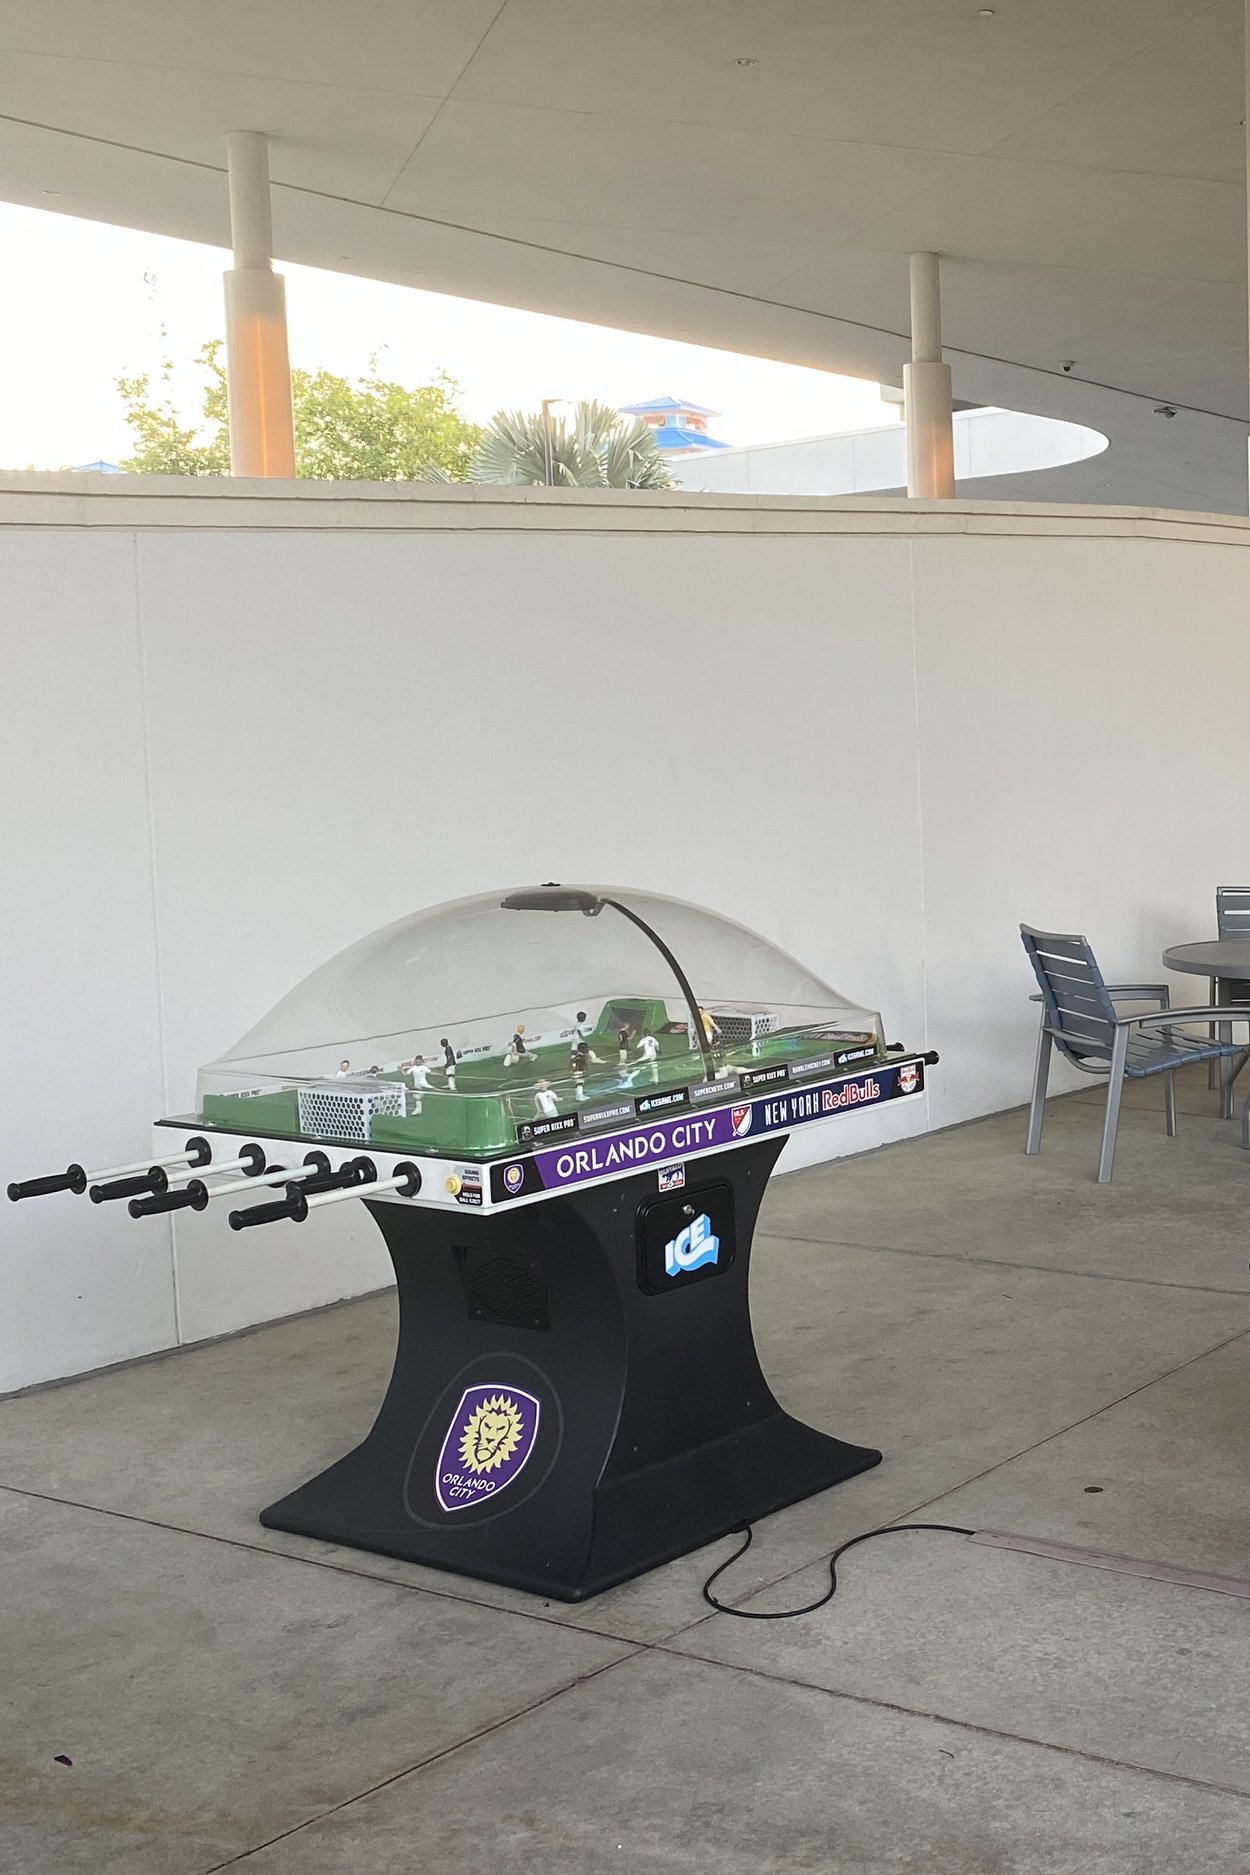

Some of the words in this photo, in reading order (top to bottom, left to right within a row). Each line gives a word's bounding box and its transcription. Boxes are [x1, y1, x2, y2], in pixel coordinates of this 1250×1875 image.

[648, 1039, 653, 1047] 2
[752, 1074, 766, 1084] SUPER
[764, 1102, 787, 1126] NEW
[791, 1092, 819, 1119] YORK
[533, 1123, 551, 1136] SUPER
[563, 1118, 575, 1129] PRO
[556, 1131, 666, 1178] ORLANDO
[672, 1118, 716, 1148] CITY
[665, 1213, 720, 1277] ICE
[442, 1473, 496, 1492] ORLANDO
[449, 1486, 476, 1499] CITY
